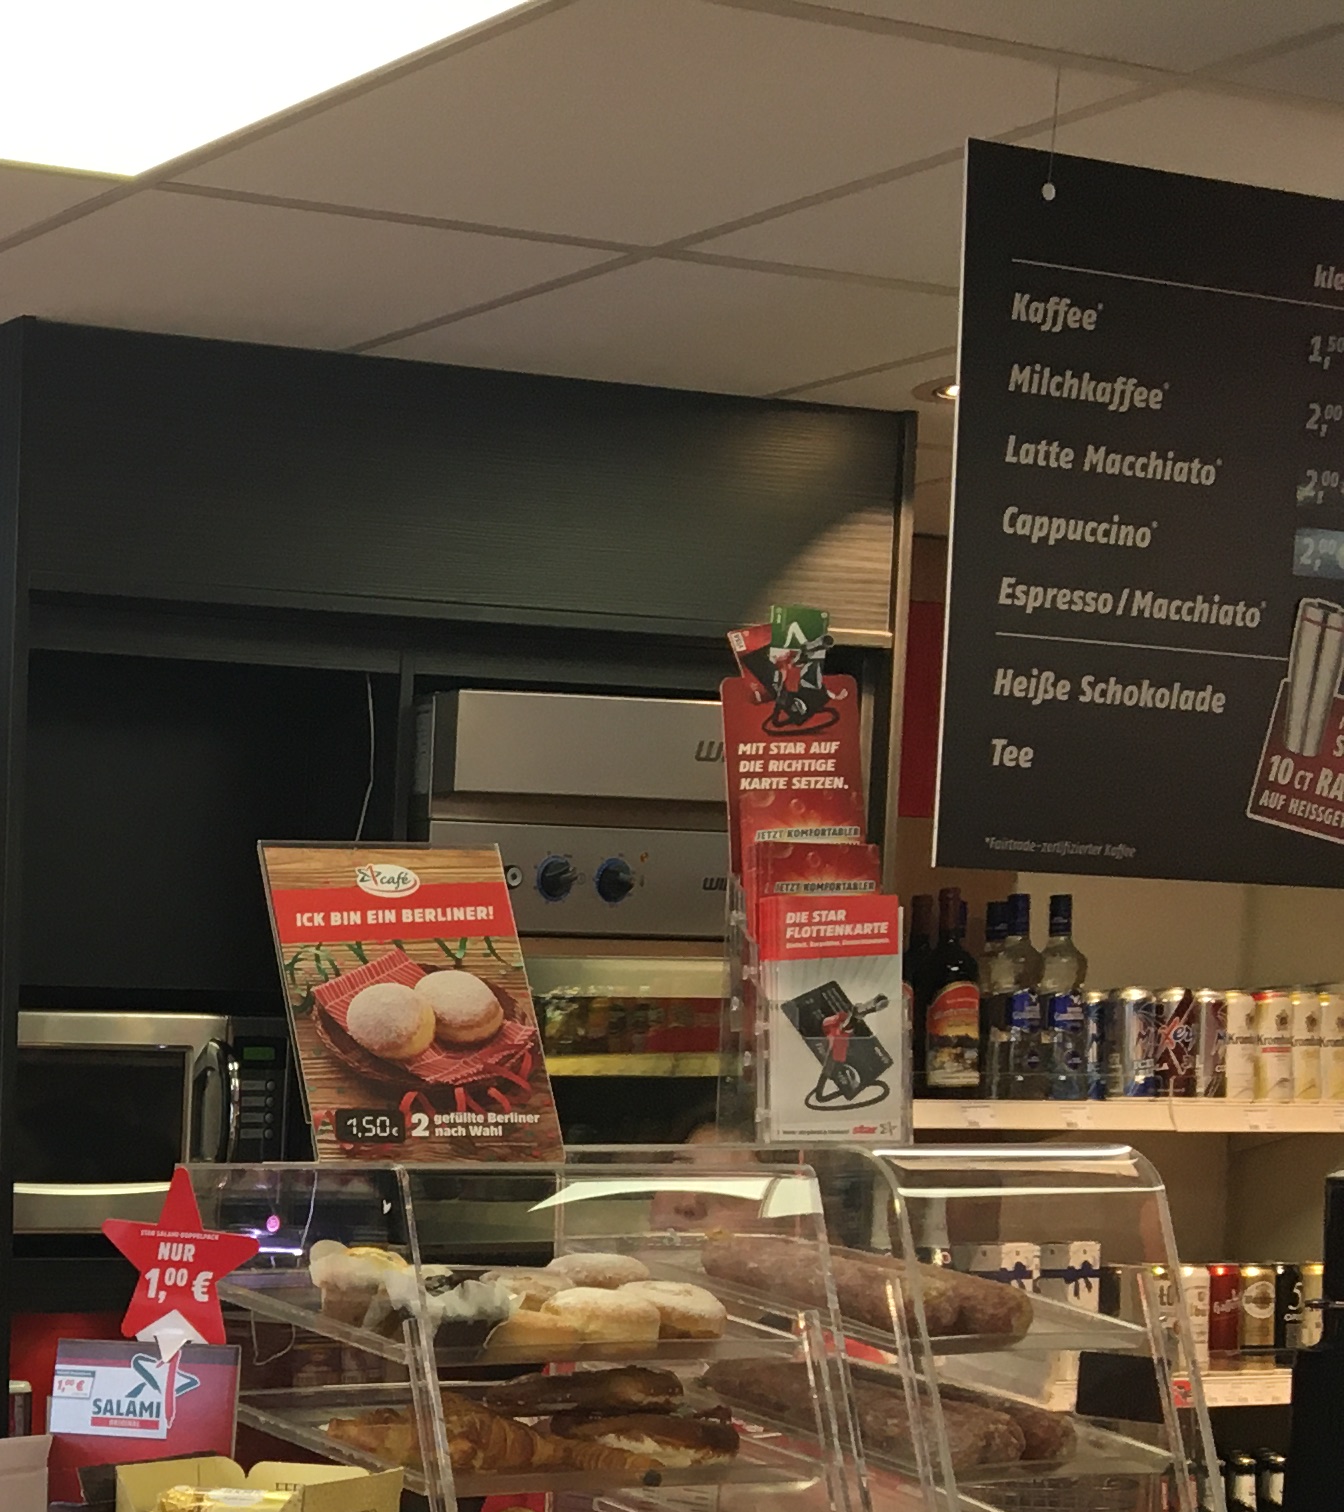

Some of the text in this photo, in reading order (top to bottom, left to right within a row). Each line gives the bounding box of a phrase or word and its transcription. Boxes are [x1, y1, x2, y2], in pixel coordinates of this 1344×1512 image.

[1005, 435, 1075, 469] Latte
[998, 577, 1113, 614] Espresso
[993, 669, 1226, 714] Heiße Schokolade
[738, 742, 840, 755] MIT STAR AUF
[991, 739, 1034, 768] Tee
[739, 759, 836, 772] DIE RICHTIGE
[740, 776, 848, 790] KARTE SETZEN.
[296, 906, 494, 927] ICK BIN EIN BERLINER!
[786, 910, 846, 924] DIE STAR
[786, 922, 889, 939] FLOTTENKARTE
[411, 1112, 540, 1137] 2 gefüllte Berliner
[435, 1126, 502, 1137] nach Wahl
[158, 1242, 195, 1262] NUR
[92, 1398, 160, 1419] SALAMI
